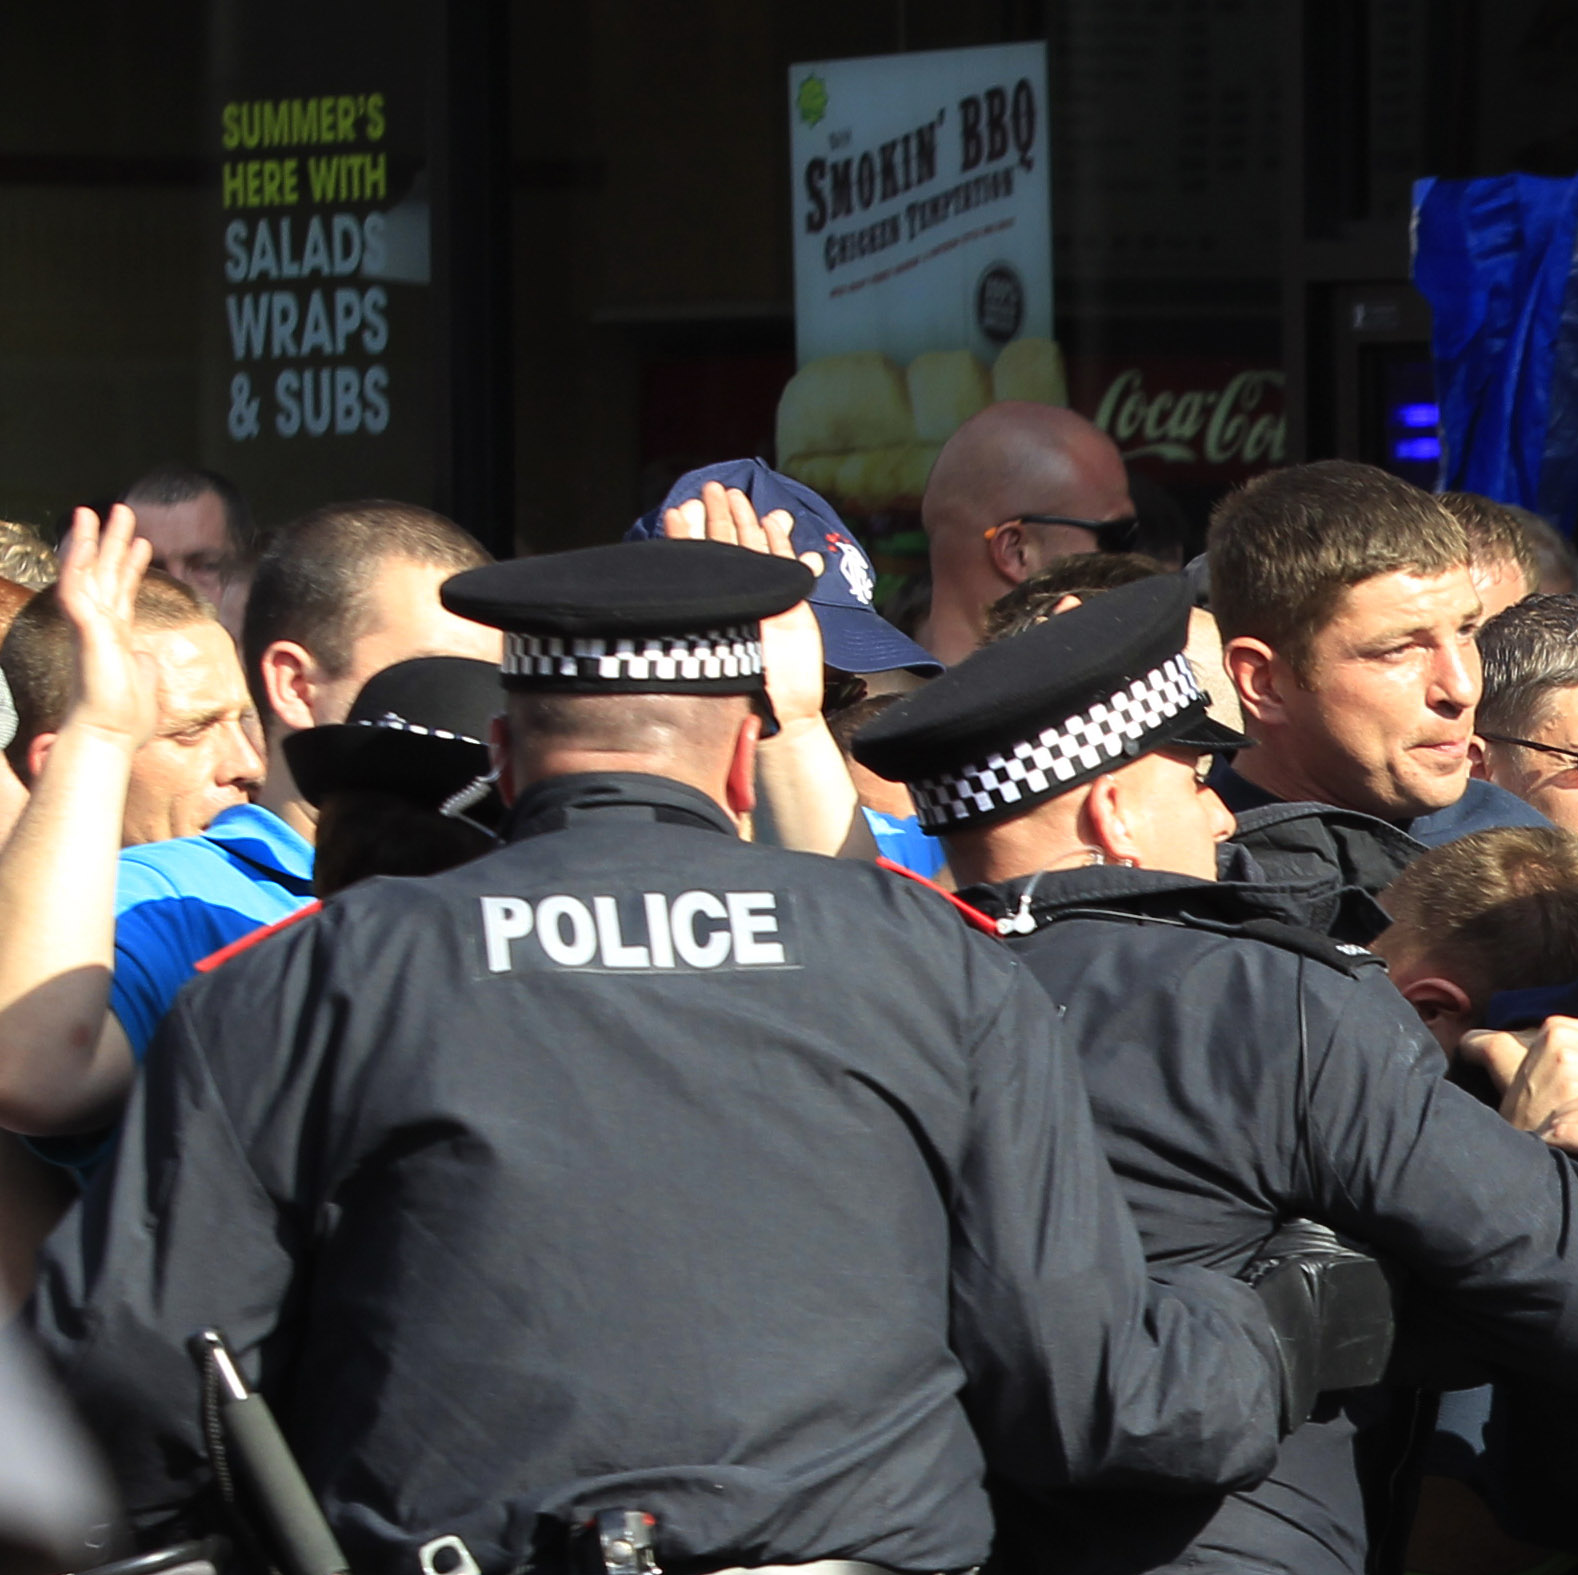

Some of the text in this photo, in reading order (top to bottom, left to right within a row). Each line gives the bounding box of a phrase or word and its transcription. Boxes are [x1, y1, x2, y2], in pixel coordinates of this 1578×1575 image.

[222, 93, 386, 149] SUMMER'S
[805, 106, 946, 235] SMOKIN'
[959, 76, 1036, 172] BBQ
[223, 153, 387, 209] HERE WITH
[224, 211, 389, 283] SALADS
[226, 286, 389, 361] WRAPS
[228, 365, 390, 441] & SUBS
[480, 891, 786, 973] POLICE
